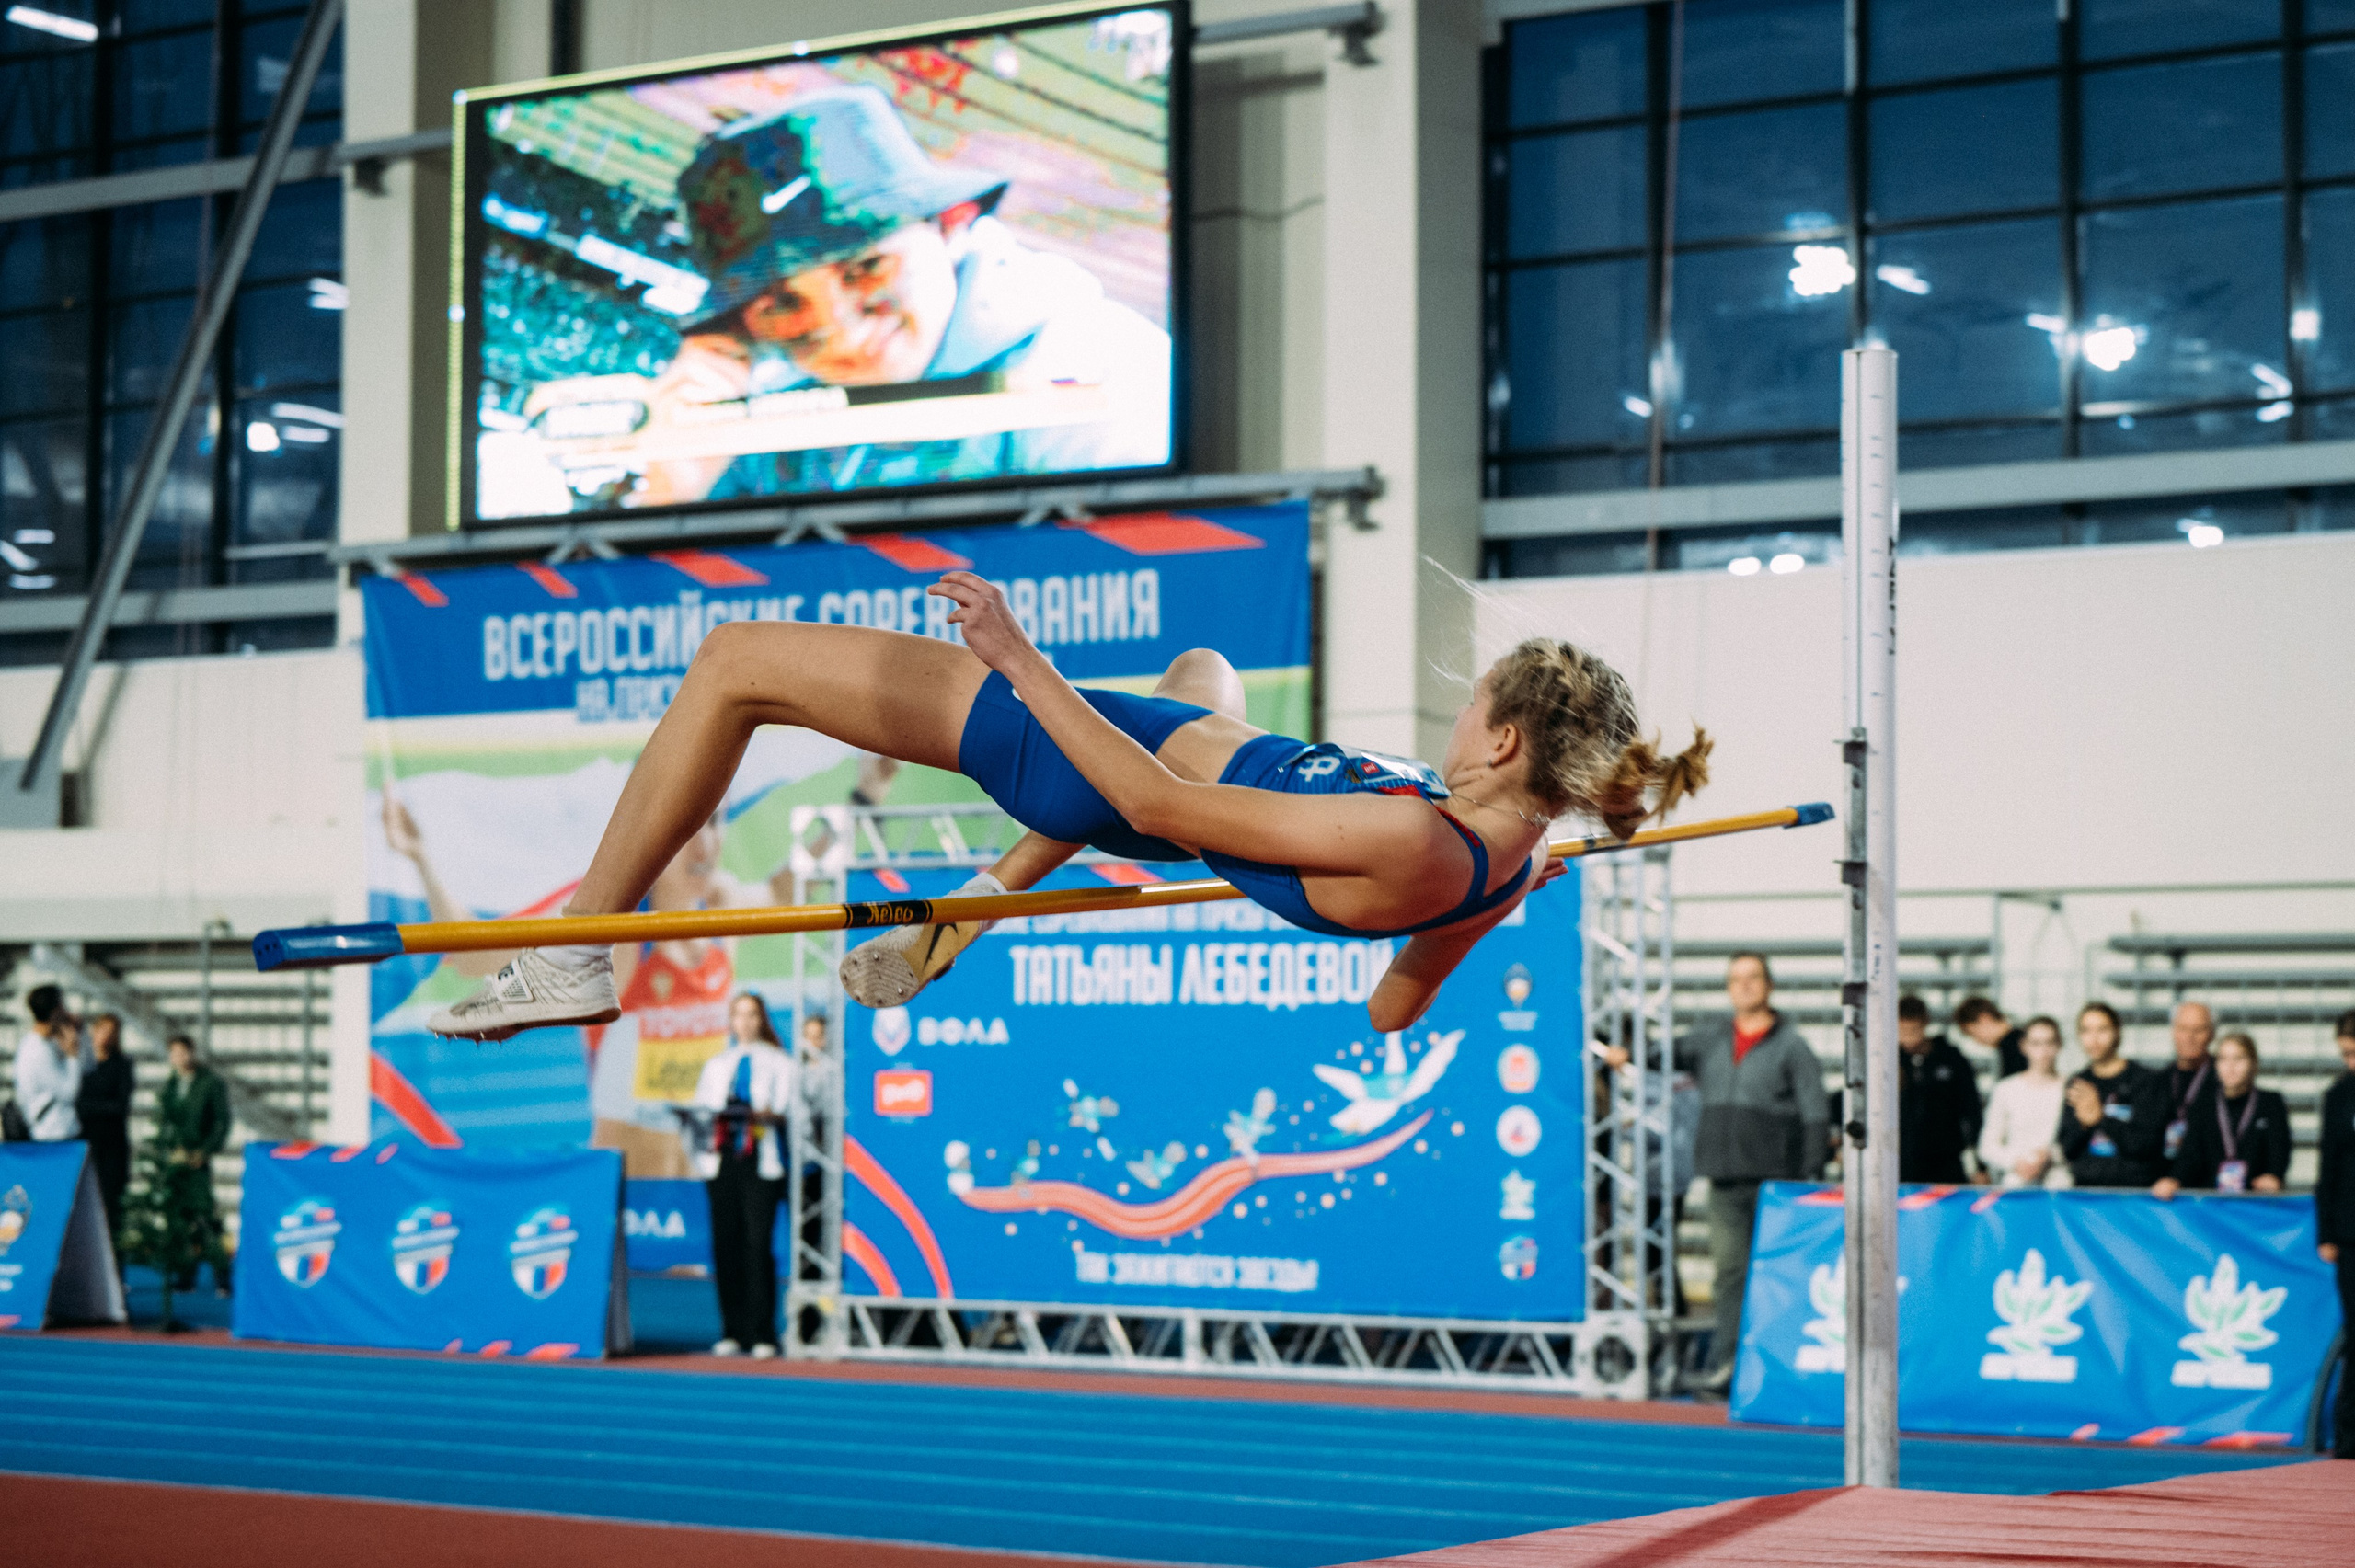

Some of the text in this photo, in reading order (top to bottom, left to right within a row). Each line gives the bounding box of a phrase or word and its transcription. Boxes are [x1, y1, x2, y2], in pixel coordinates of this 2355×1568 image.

[817, 567, 1160, 646] СОРЕВВАНИЯ
[1008, 938, 1395, 1011] ТАТЬЯНЫ ЛЕБЕДЕВОЙ
